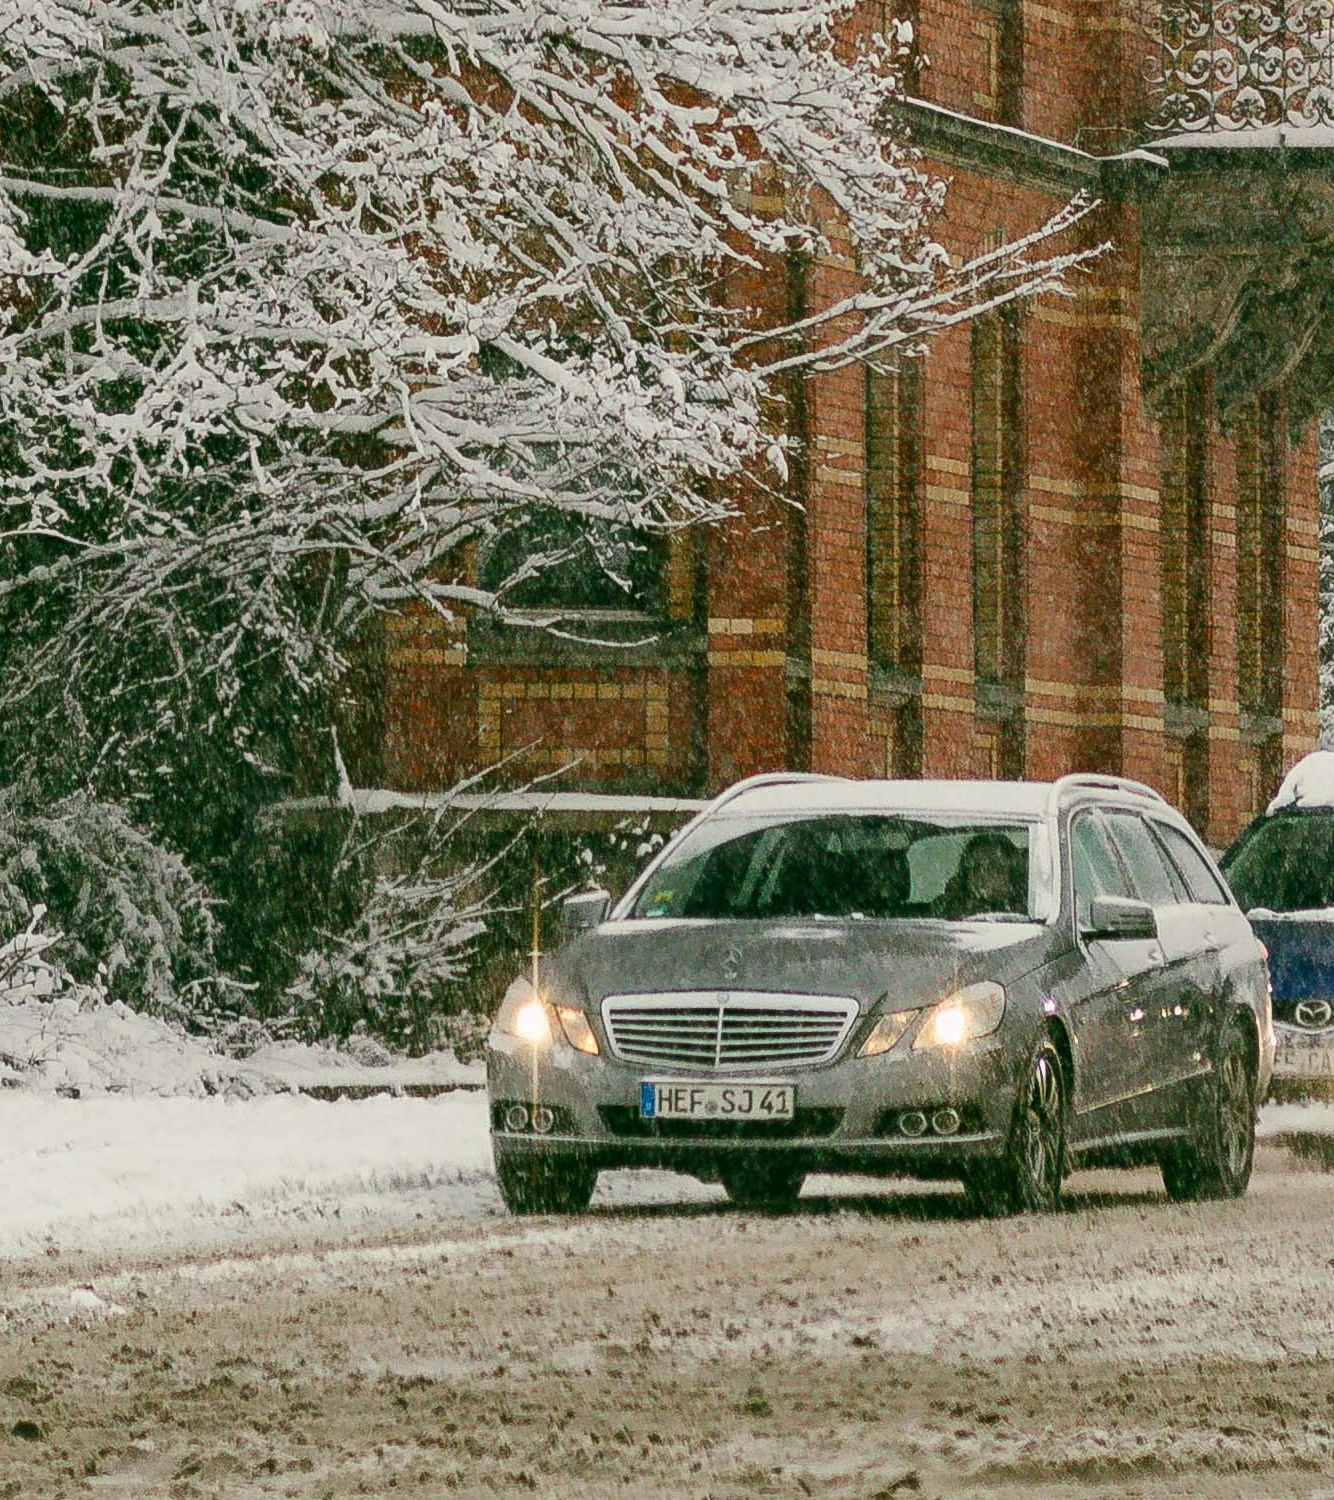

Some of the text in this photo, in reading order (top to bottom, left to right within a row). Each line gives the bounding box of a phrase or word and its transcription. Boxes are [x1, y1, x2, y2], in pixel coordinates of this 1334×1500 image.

[658, 1089, 789, 1114] HEF SJ 41
